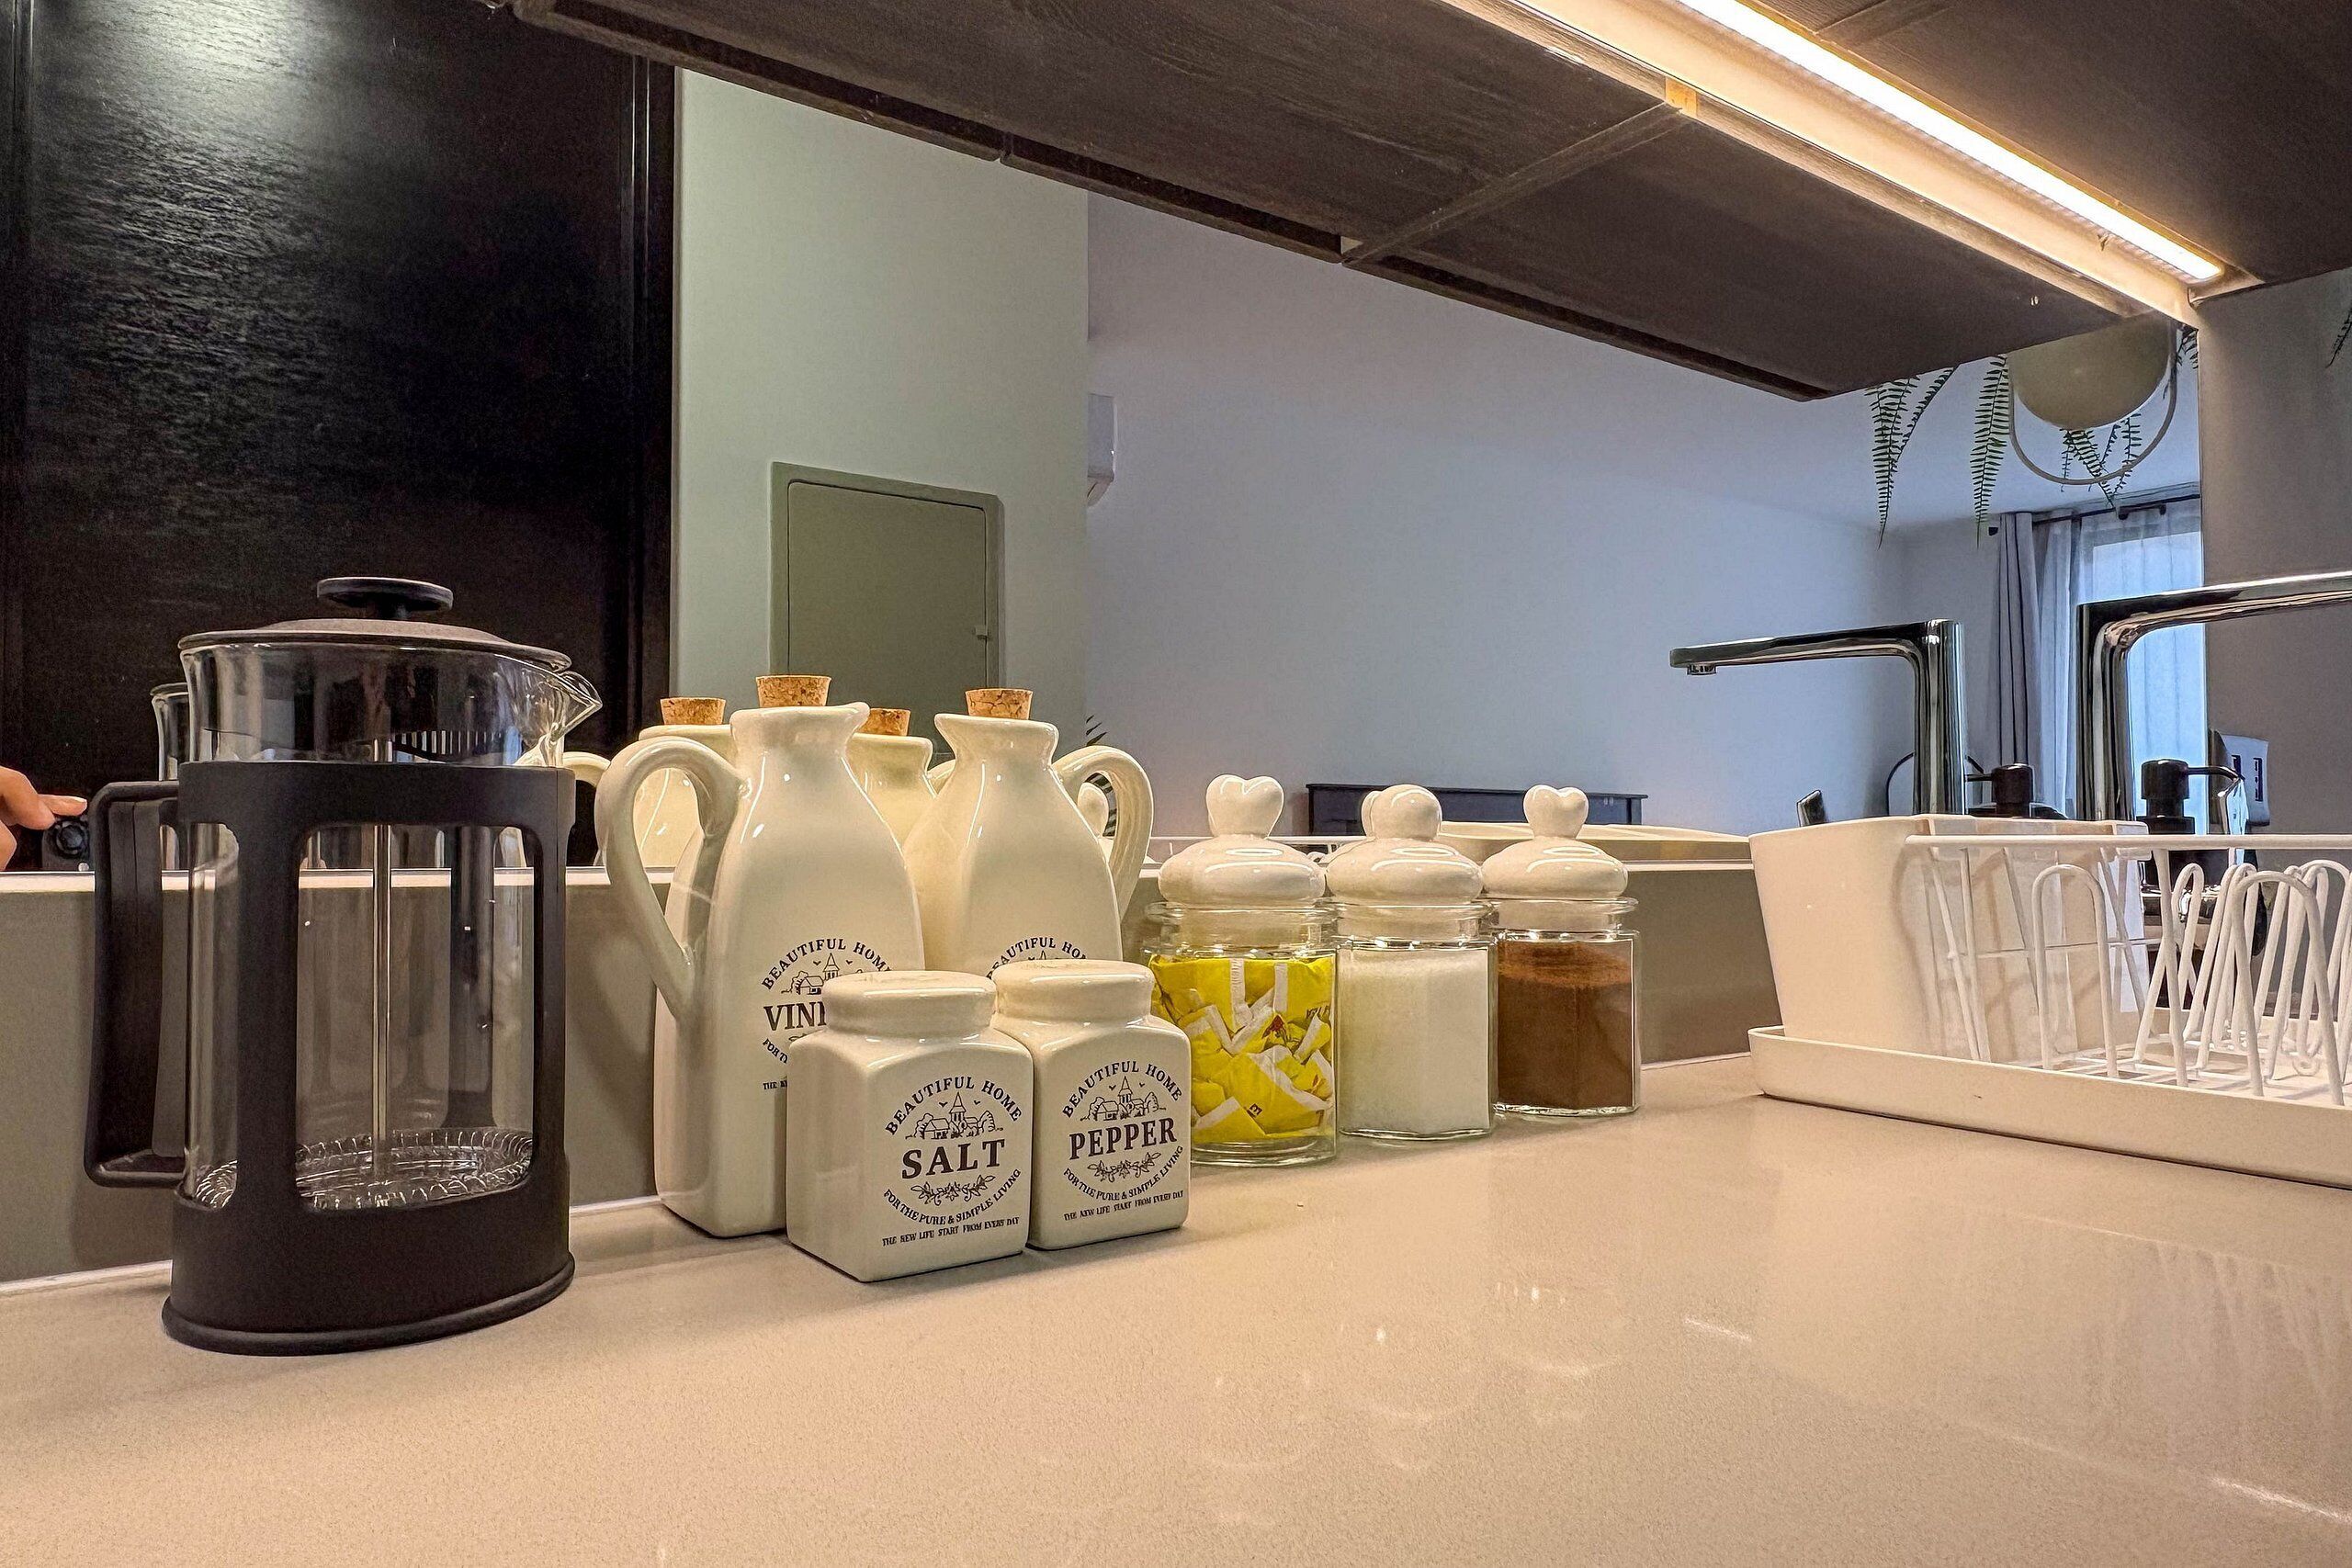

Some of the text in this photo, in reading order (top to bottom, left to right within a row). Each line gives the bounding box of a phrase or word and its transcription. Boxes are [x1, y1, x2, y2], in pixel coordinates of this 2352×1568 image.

[761, 938, 847, 990] BEAUTIFUL
[762, 1038, 780, 1057] FOR
[762, 1081, 777, 1090] THE
[885, 1076, 1023, 1135] BEAUTIFUL HOME
[1062, 1060, 1183, 1118] BEAUTIFUL HOME
[901, 1139, 1005, 1179] SALT
[1069, 1117, 1177, 1160] PEPPER
[1063, 1145, 1184, 1201] FOR THE PURE & SIMPLE LIVING
[883, 1168, 1022, 1225] FOR THE PURE & SIMPLE LIVING
[1063, 1212, 1078, 1222] THE
[1096, 1205, 1111, 1215] LIFE
[1114, 1201, 1132, 1213] START
[1135, 1197, 1152, 1208] FROM
[882, 1236, 898, 1247] THE
[899, 1232, 917, 1243] NEW
[918, 1229, 935, 1239] LIFE
[938, 1225, 959, 1236] START
[963, 1223, 983, 1234] FROM
